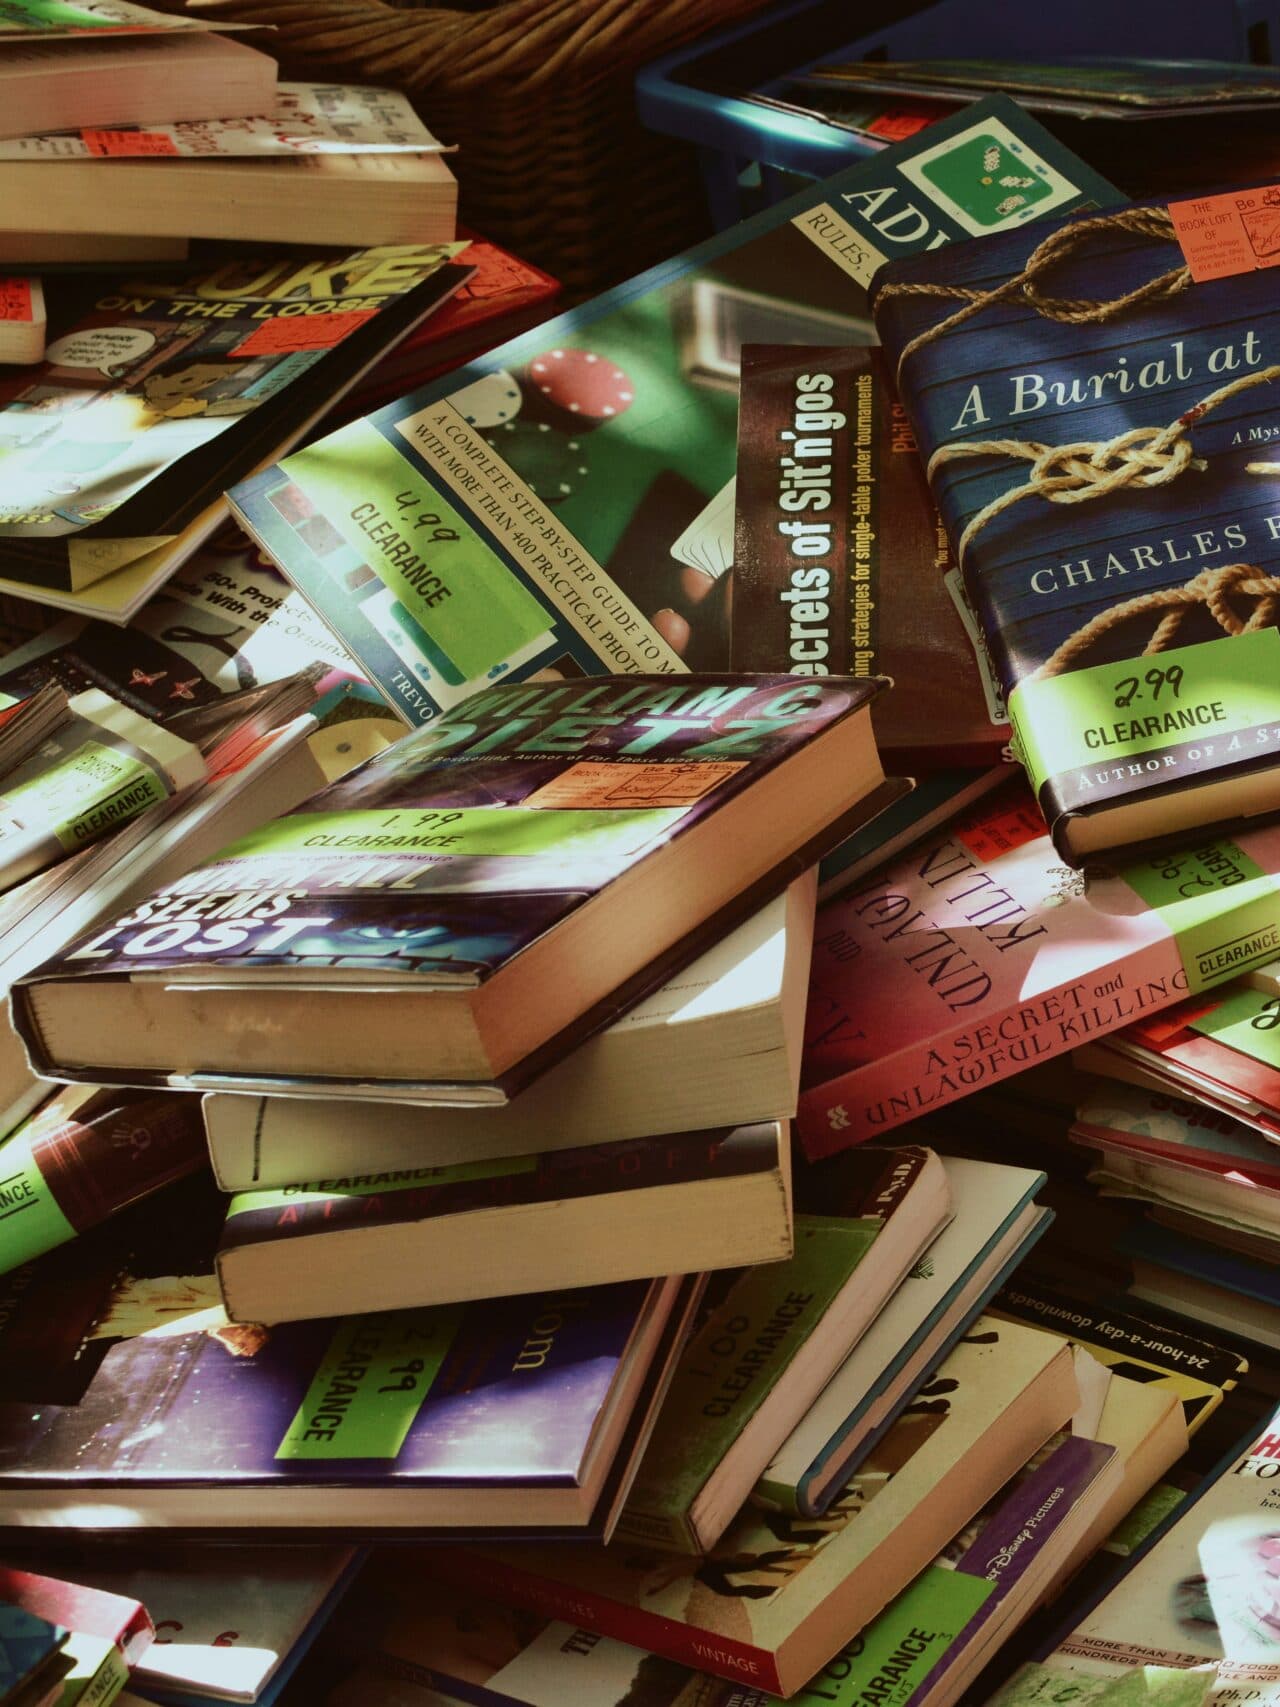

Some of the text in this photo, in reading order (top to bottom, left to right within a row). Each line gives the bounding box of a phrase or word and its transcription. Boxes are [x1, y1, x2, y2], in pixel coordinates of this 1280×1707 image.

[1179, 212, 1233, 233] BOOK LOFT
[1191, 201, 1213, 214] THE
[1234, 198, 1256, 211] Be
[806, 211, 862, 272] RULES,
[1203, 229, 1219, 241] OF
[167, 299, 240, 318] THE
[251, 295, 391, 318] LOOSE
[951, 384, 991, 431] A
[1008, 341, 1193, 418] Burial
[1206, 327, 1263, 378] at
[1232, 431, 1243, 446] A
[394, 489, 462, 545] 4.99
[413, 421, 600, 636] WITH MORE THAN 400 PRACTICAL
[850, 374, 876, 648] strategies for single-table poker tournaments
[349, 502, 454, 609] CLEARANCE
[432, 412, 662, 661] A COMPLETE STEP-BY-STEP GUIDE TO
[778, 521, 831, 557] of
[1030, 523, 1249, 596] CHARLES
[203, 571, 314, 624] 50+ Projects
[205, 590, 281, 628] With the
[390, 669, 437, 722] TREVO
[455, 685, 753, 720] WILLIAM
[1113, 664, 1186, 709] 2.99
[1083, 700, 1227, 751] CLEARANCE
[1077, 750, 1178, 792] AUTHOR
[1186, 742, 1217, 763] OF
[1226, 731, 1244, 752] A
[73, 783, 156, 841] CLEARANCE
[303, 834, 464, 851] CLEARANCE
[317, 863, 437, 890] ALL
[916, 840, 1050, 954] KILLIN
[115, 889, 308, 929] SEEMS
[67, 917, 335, 961] LOST
[865, 969, 1191, 1127] UNLAWFUL KILLING
[924, 973, 1126, 1076] A SECRET and
[703, 1291, 814, 1421] CLEARANCE
[1096, 1321, 1211, 1371] 24-hour-a-day
[1025, 1485, 1066, 1530] Pictures
[691, 1641, 760, 1677] VINTAGE
[1058, 1644, 1142, 1667] HUNDREDS
[1083, 1637, 1124, 1652] MORE
[1128, 1644, 1172, 1658] THAN
[1240, 1662, 1280, 1673] FOOD
